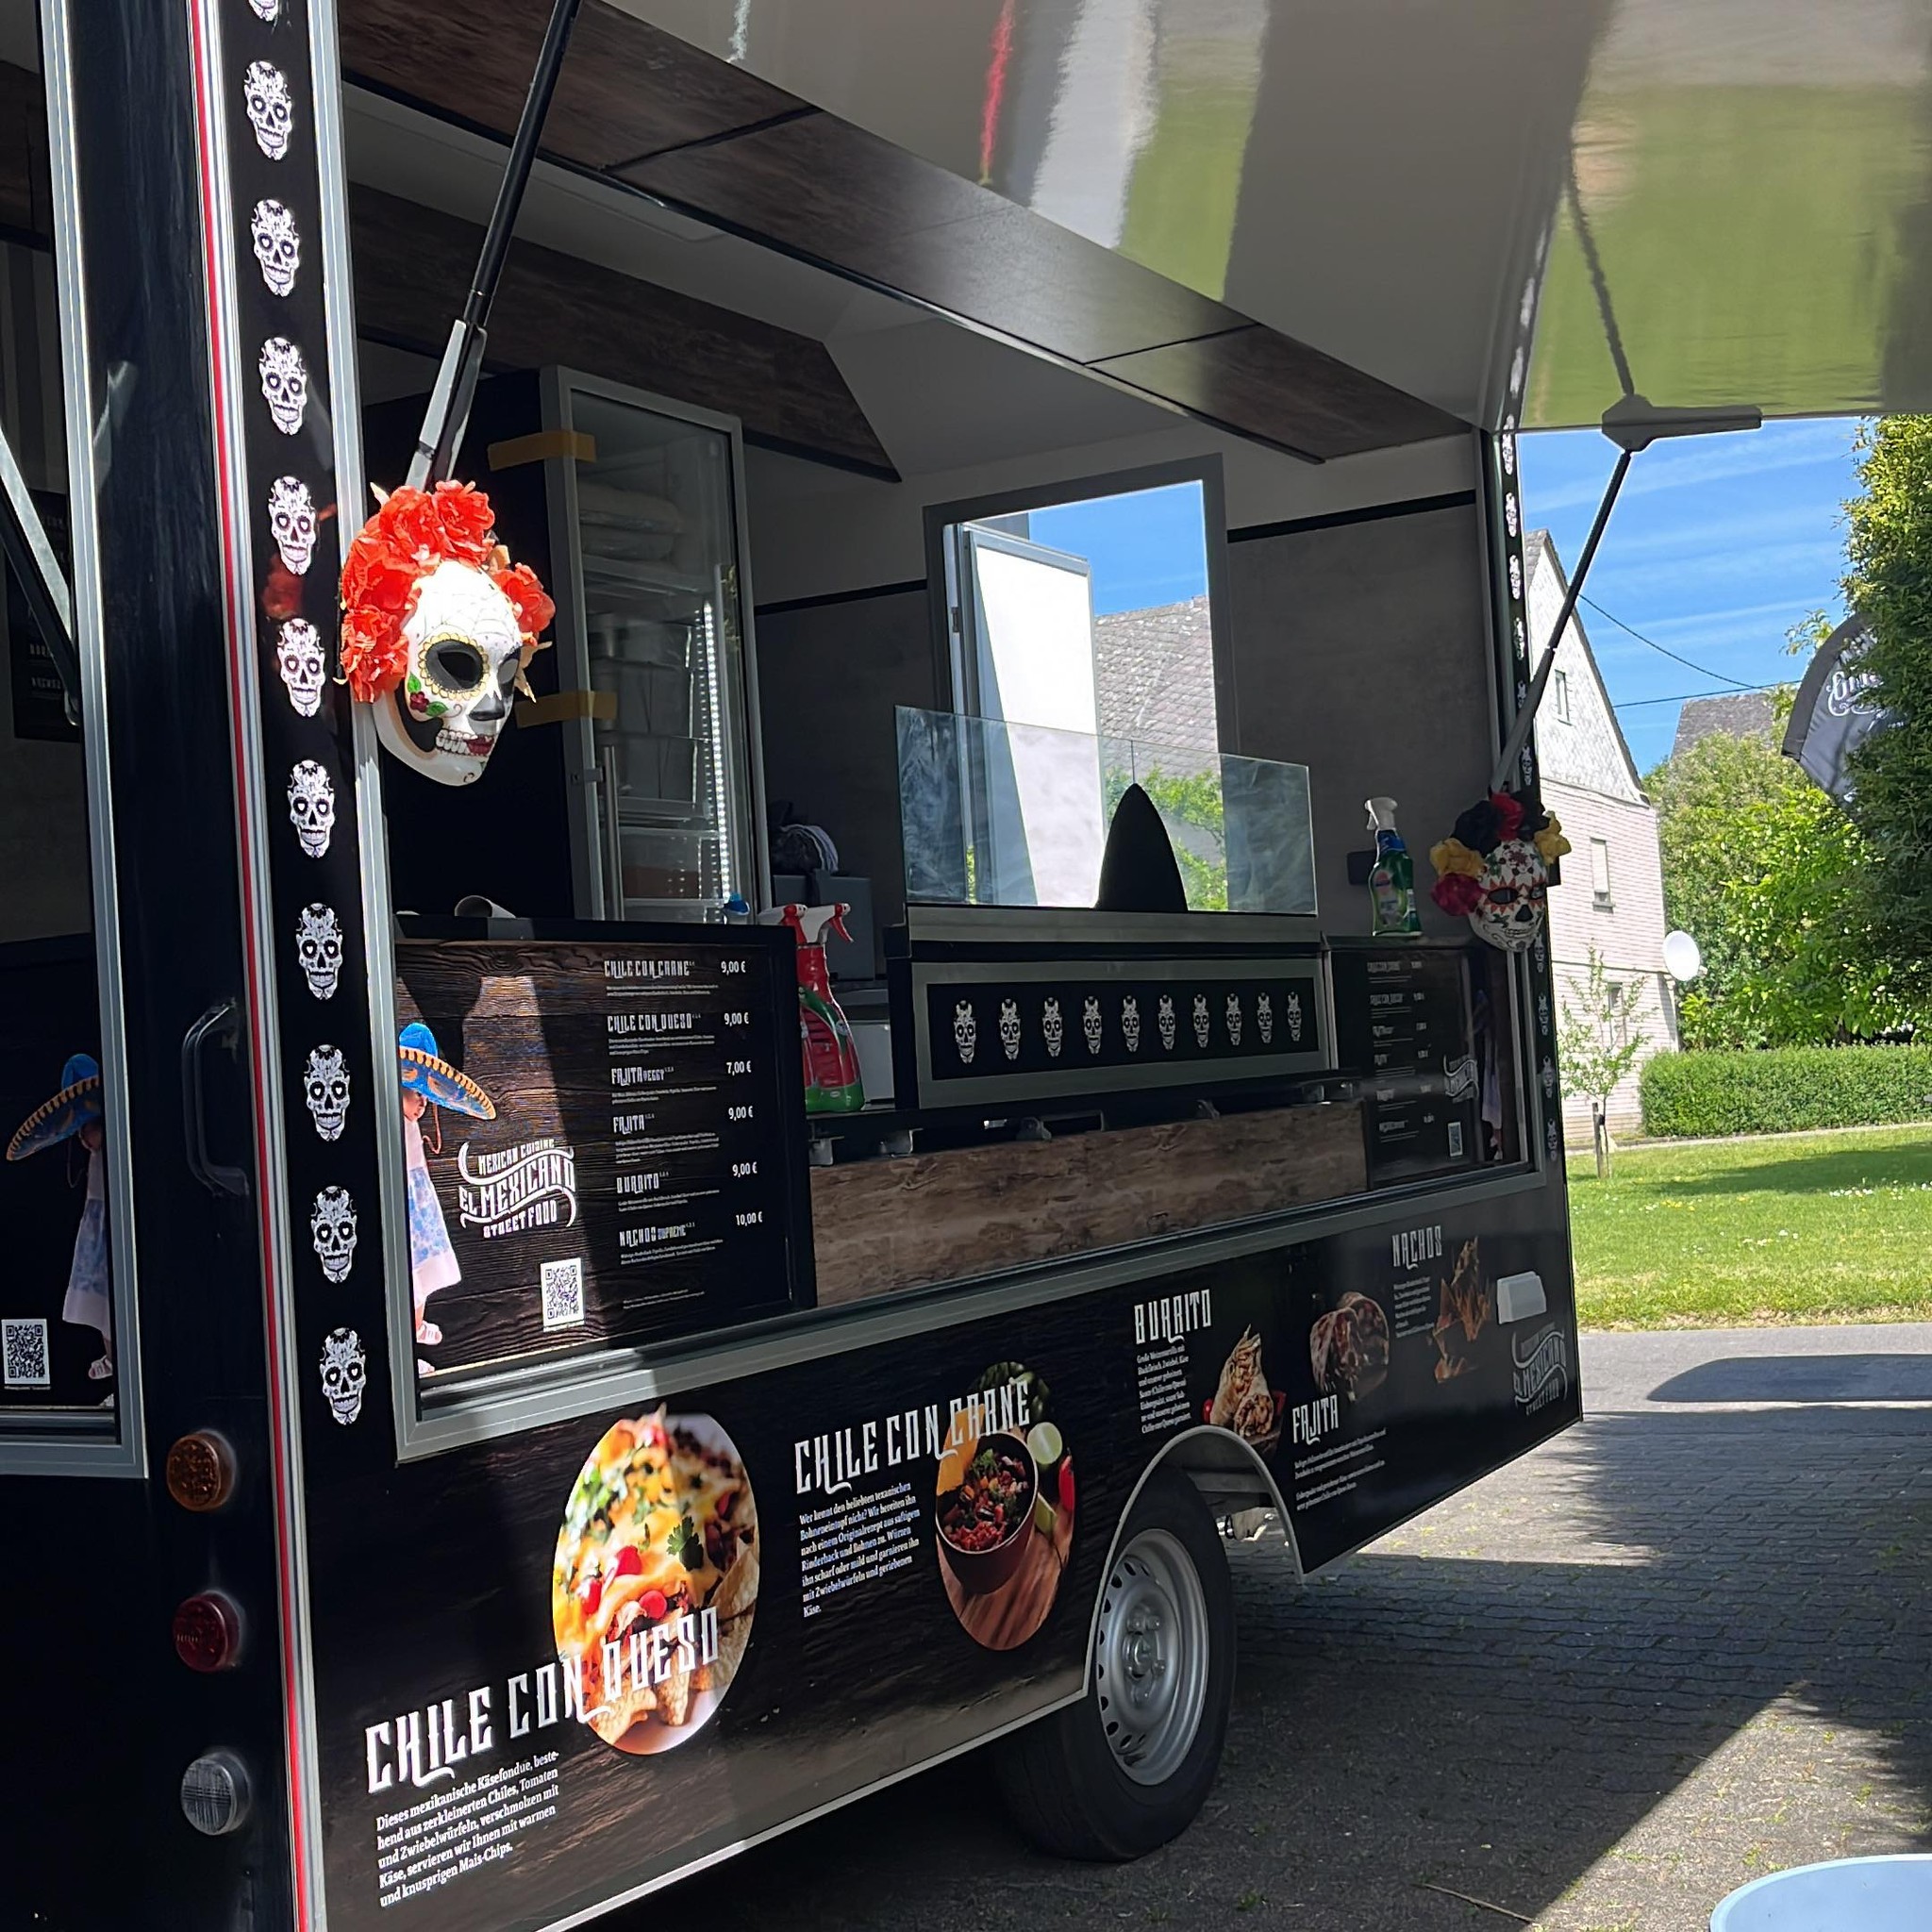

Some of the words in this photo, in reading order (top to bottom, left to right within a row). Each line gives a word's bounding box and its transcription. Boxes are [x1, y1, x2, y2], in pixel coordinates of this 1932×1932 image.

[605, 960, 633, 979] CHILE
[636, 960, 661, 979] CON
[658, 960, 690, 976] CARNE
[721, 961, 739, 975] 9,00
[741, 961, 746, 973] €
[608, 1015, 636, 1034] CHILE
[639, 1014, 663, 1032] CON
[661, 1013, 691, 1029] QUESO
[724, 1013, 742, 1026] 9,00
[744, 1012, 749, 1024] €
[611, 1067, 642, 1086] FAJITA
[643, 1069, 664, 1082] VEGGY
[726, 1061, 744, 1075] 7,00
[746, 1060, 751, 1073] €
[613, 1114, 644, 1135] FAJITA
[728, 1107, 746, 1121] 9,00
[748, 1106, 753, 1118] €
[478, 1147, 518, 1175] MEXICAN
[617, 1173, 659, 1193] BURRITO
[732, 1164, 751, 1177] 9,00
[752, 1162, 758, 1174] €
[458, 1187, 477, 1215] EL
[480, 1155, 575, 1219] MEXICANO
[483, 1211, 525, 1238] STREET
[528, 1200, 557, 1227] FOOD
[620, 1226, 656, 1247] NACHOS
[736, 1213, 757, 1226] 10,00
[758, 1211, 762, 1223] €
[1392, 1225, 1442, 1270] NACHOS
[1134, 1289, 1211, 1344] BURRITO
[794, 1421, 878, 1495] CHILE
[886, 1404, 958, 1467] CON
[949, 1380, 1030, 1446] CARNE
[1292, 1394, 1339, 1445] FAJITA
[799, 1513, 813, 1524] Wer
[813, 1506, 833, 1521] kennt
[833, 1504, 845, 1515] den
[845, 1493, 874, 1510] beliebten
[875, 1482, 911, 1501] texanischen
[848, 1509, 868, 1524] nicht?
[868, 1506, 879, 1517] Wir
[879, 1499, 905, 1513] bereiten
[905, 1495, 916, 1506] ihn
[801, 1541, 817, 1556] nach
[818, 1537, 838, 1551] einem
[838, 1521, 883, 1543] Originalrezept
[883, 1517, 894, 1527] aus
[801, 1550, 840, 1572] Rinderhack
[840, 1545, 853, 1558] und
[853, 1538, 876, 1553] Bohnen
[802, 1575, 814, 1587] ihn
[814, 1565, 835, 1583] scharf
[835, 1562, 850, 1575] oder
[850, 1556, 865, 1570] mild
[866, 1551, 878, 1564] und
[878, 1541, 908, 1561] garnieren
[908, 1537, 920, 1549] ihn
[803, 1591, 815, 1602] mit
[815, 1572, 865, 1598] Zwiebelwürfeln
[866, 1565, 878, 1579] und
[804, 1604, 822, 1618] Käse.
[365, 1685, 492, 1793] CHILE
[508, 1652, 613, 1740] CON
[599, 1607, 719, 1703] QUESO
[376, 1809, 408, 1831] Dieses
[410, 1782, 477, 1817] mexikanische
[477, 1761, 533, 1791] Käsefondue,
[534, 1751, 559, 1768] beste-
[376, 1831, 404, 1850] hend
[405, 1824, 422, 1839] aus
[424, 1797, 488, 1831] zerkleinerten
[488, 1785, 519, 1805] Chiles,
[519, 1768, 558, 1791] Tomaten
[378, 1852, 399, 1869] und
[400, 1820, 479, 1859] Zwiebelwürfeln,
[480, 1794, 542, 1826] verschmolzen
[543, 1785, 558, 1800] mit
[379, 1867, 407, 1890] Käse,
[408, 1848, 454, 1876] servieren
[455, 1840, 472, 1856] wir
[472, 1828, 501, 1849] Ihnen
[502, 1820, 518, 1837] mit
[519, 1805, 556, 1828] warmen
[380, 1889, 401, 1907] und
[402, 1866, 458, 1898] knusprigen
[459, 1841, 512, 1874] Mais-Chips.
